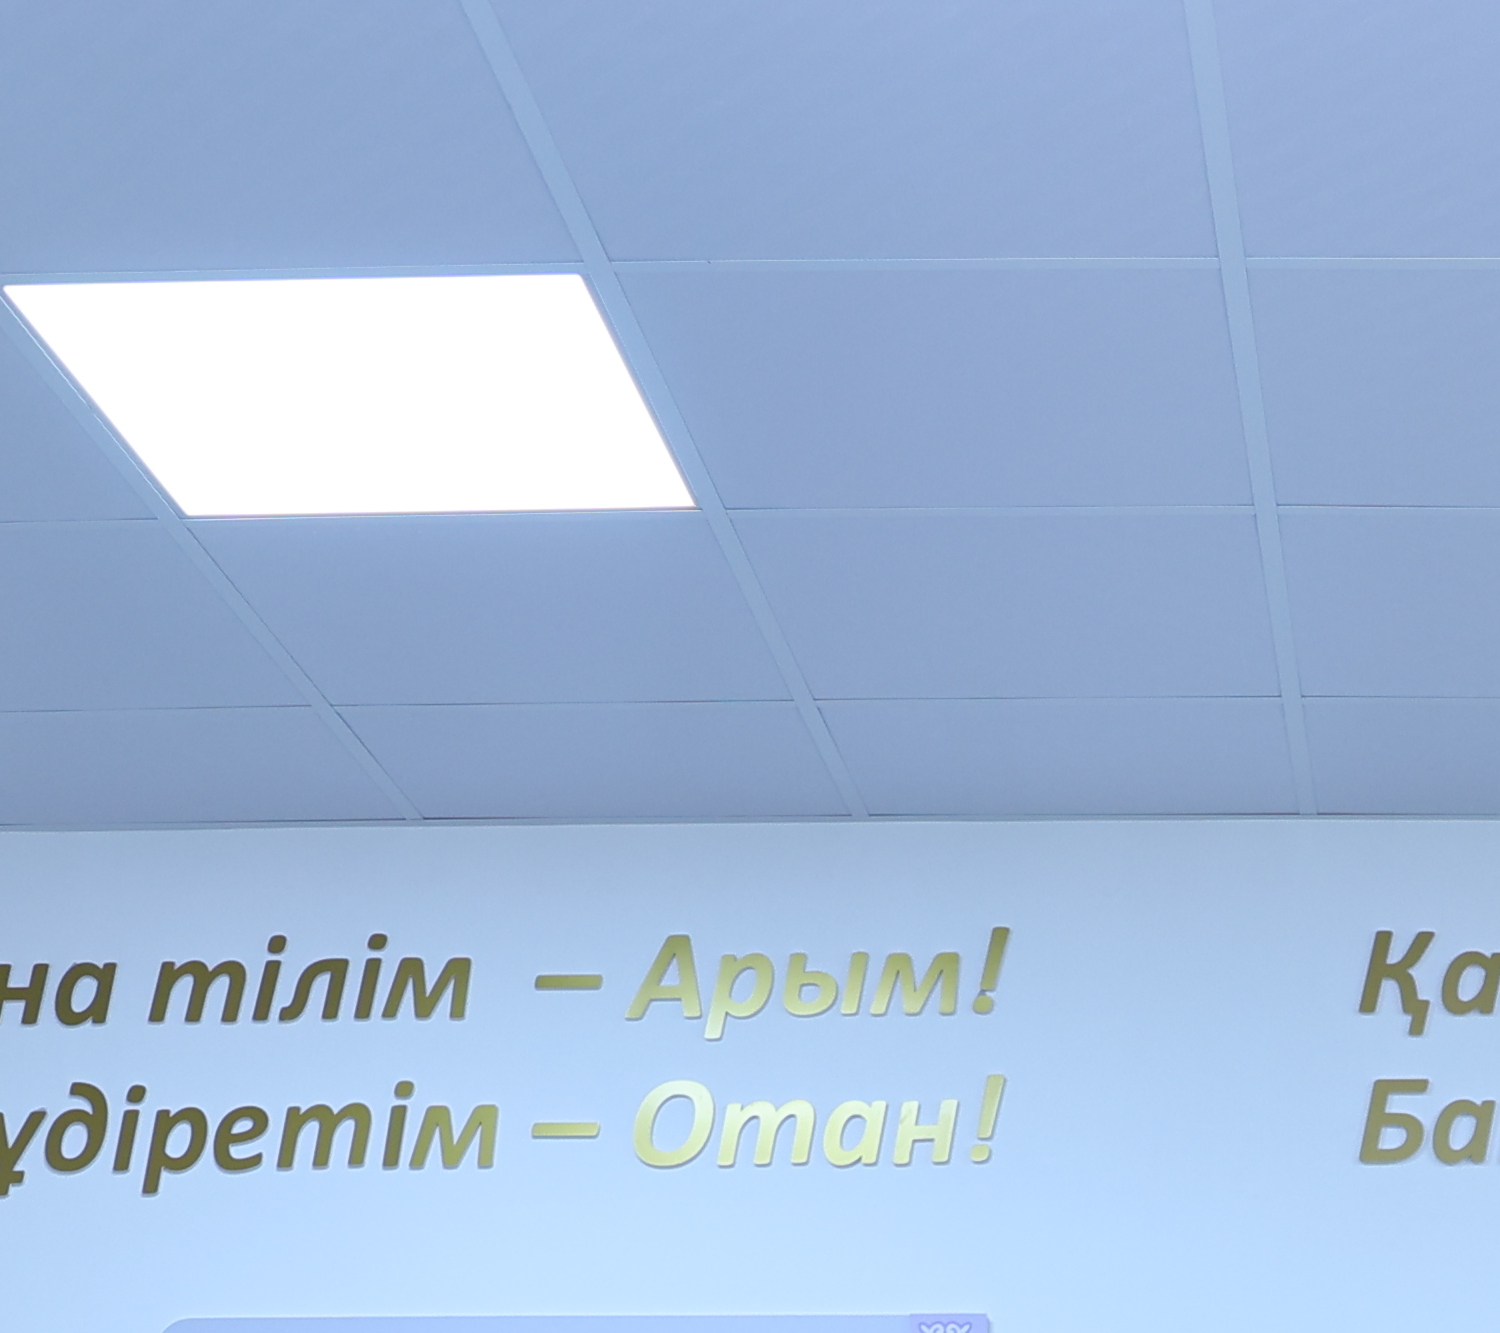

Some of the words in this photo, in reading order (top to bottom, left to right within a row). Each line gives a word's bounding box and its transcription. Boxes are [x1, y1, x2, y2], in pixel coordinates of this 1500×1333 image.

[148, 933, 472, 1022] тілім
[624, 926, 1010, 1041] Арым!
[633, 1073, 1005, 1167] Отан!
